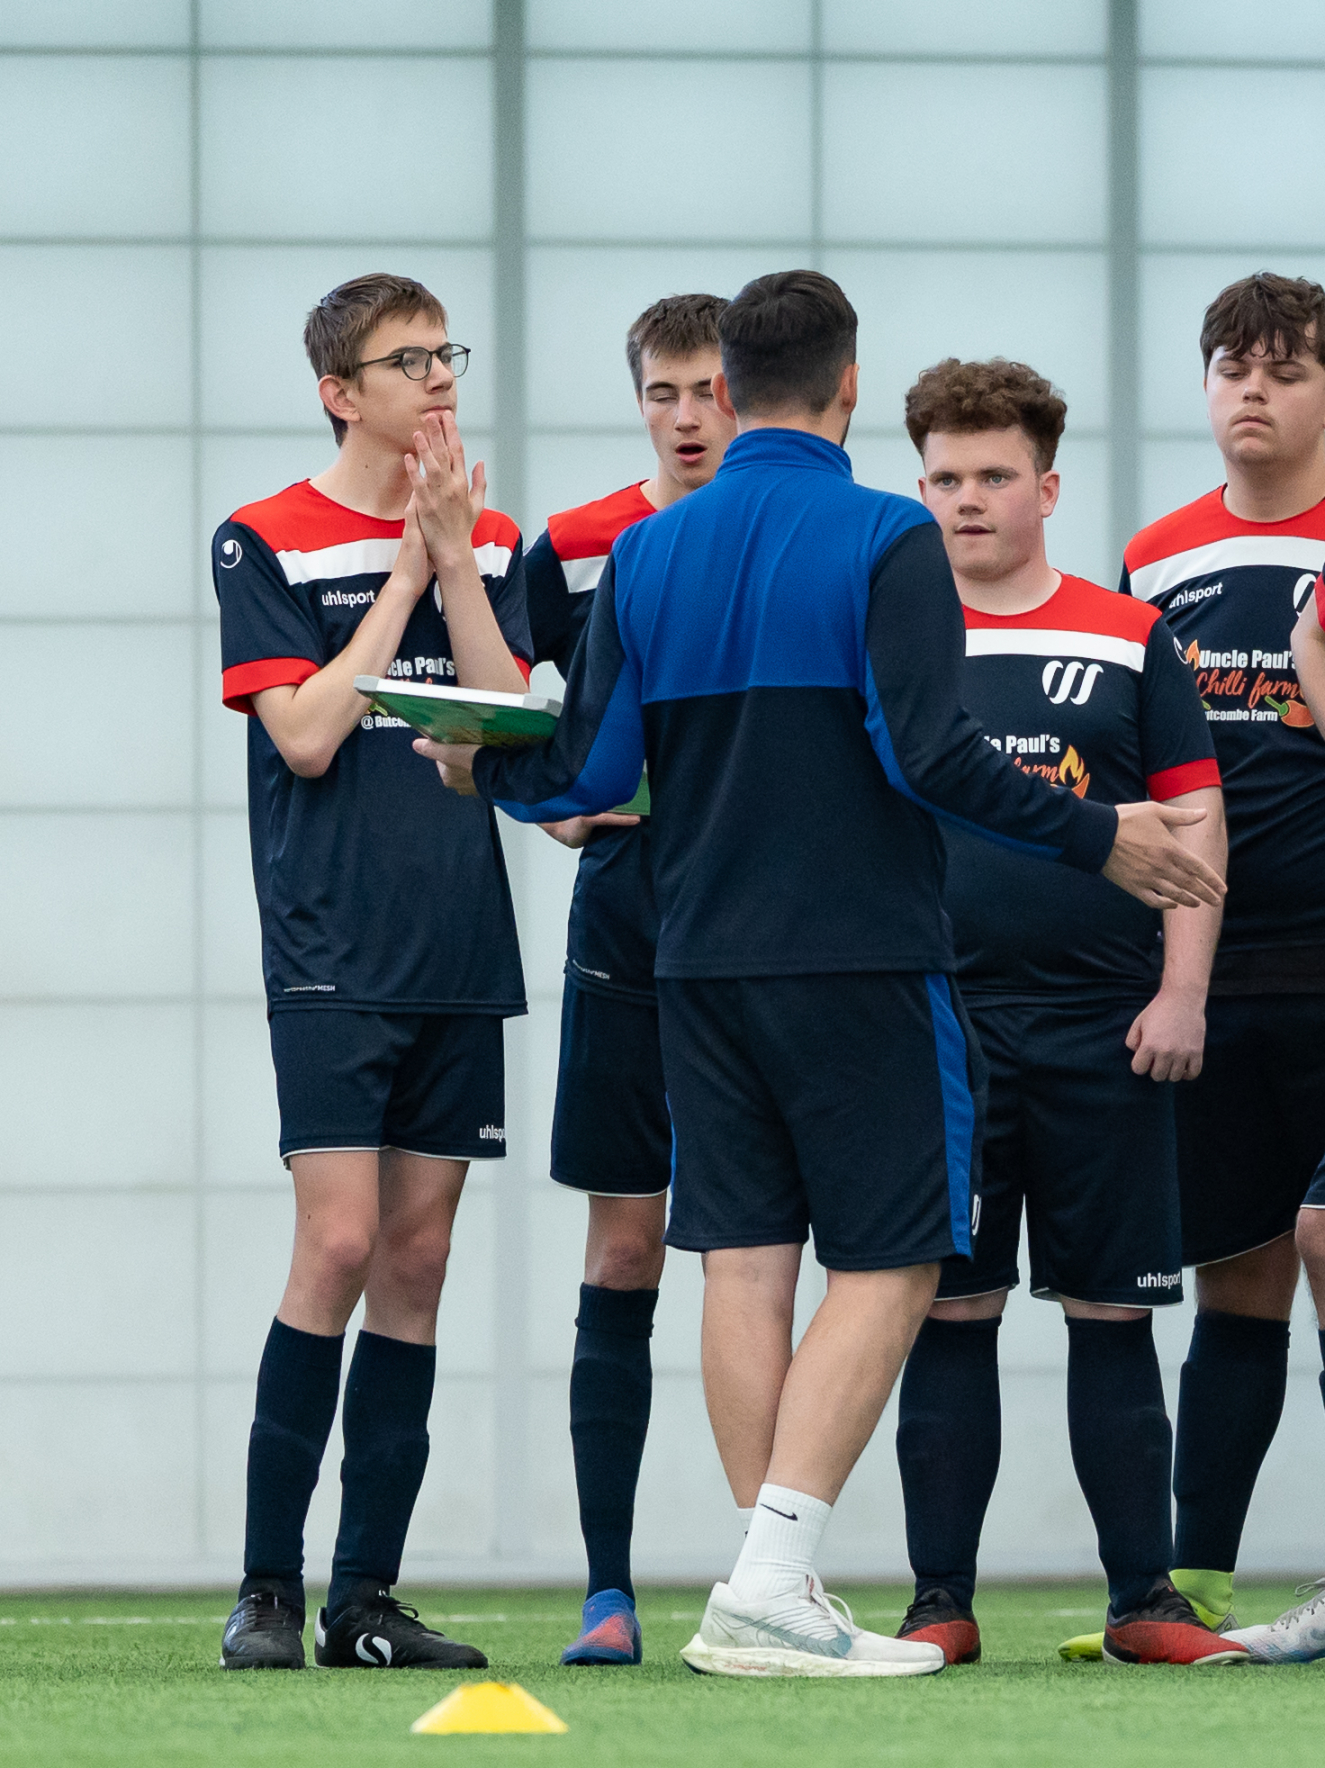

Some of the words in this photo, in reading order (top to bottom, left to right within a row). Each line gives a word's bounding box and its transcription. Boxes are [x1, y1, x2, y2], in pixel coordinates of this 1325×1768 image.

[321, 590, 376, 608] uhlsport
[1168, 582, 1223, 609] uhlsport
[1200, 649, 1248, 669] Uncle
[1197, 668, 1247, 697] Chilli
[1248, 672, 1301, 709] farm
[1251, 709, 1278, 722] Farm
[1006, 734, 1061, 754] Paul's
